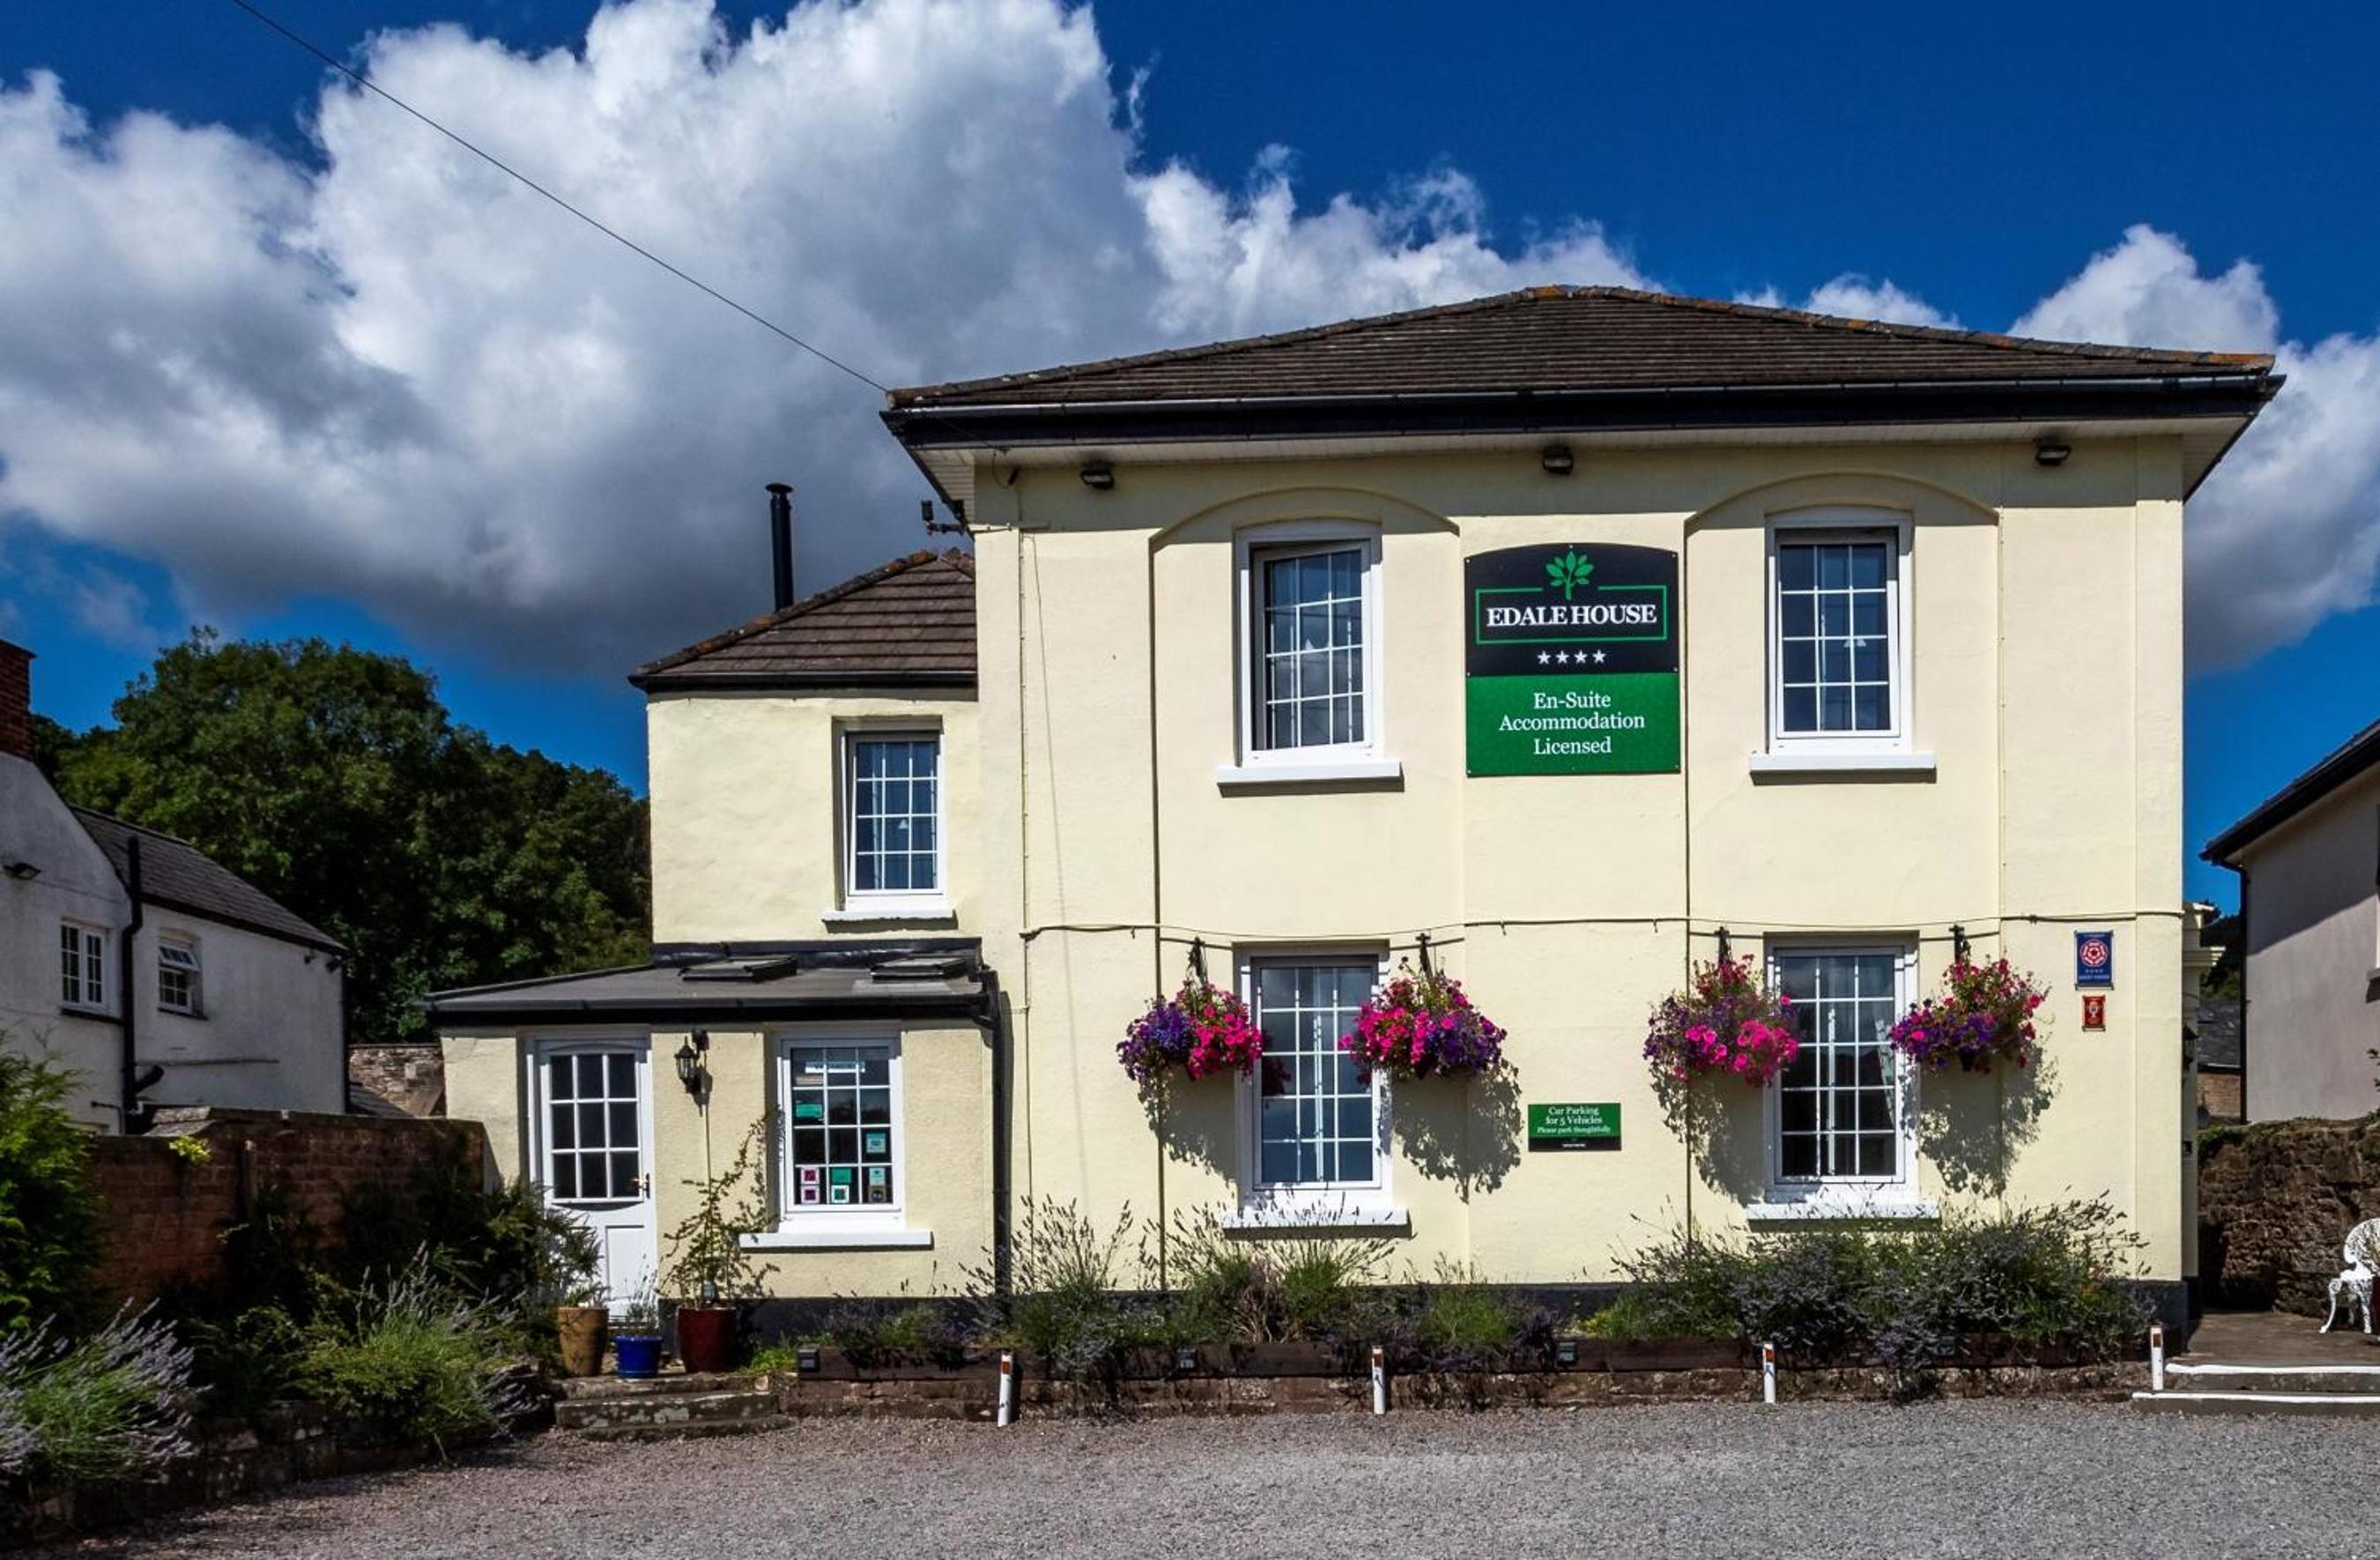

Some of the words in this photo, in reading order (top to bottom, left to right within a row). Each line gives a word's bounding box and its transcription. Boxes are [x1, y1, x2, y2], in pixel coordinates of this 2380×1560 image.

[1487, 606, 1568, 627] EDALE
[1571, 605, 1657, 624] HOUSE
[1533, 691, 1611, 709] En-Suite
[1499, 712, 1645, 731] Accommodation
[1533, 737, 1612, 754] Licensed
[1548, 1106, 1564, 1115] Car
[1566, 1106, 1599, 1116] Parking
